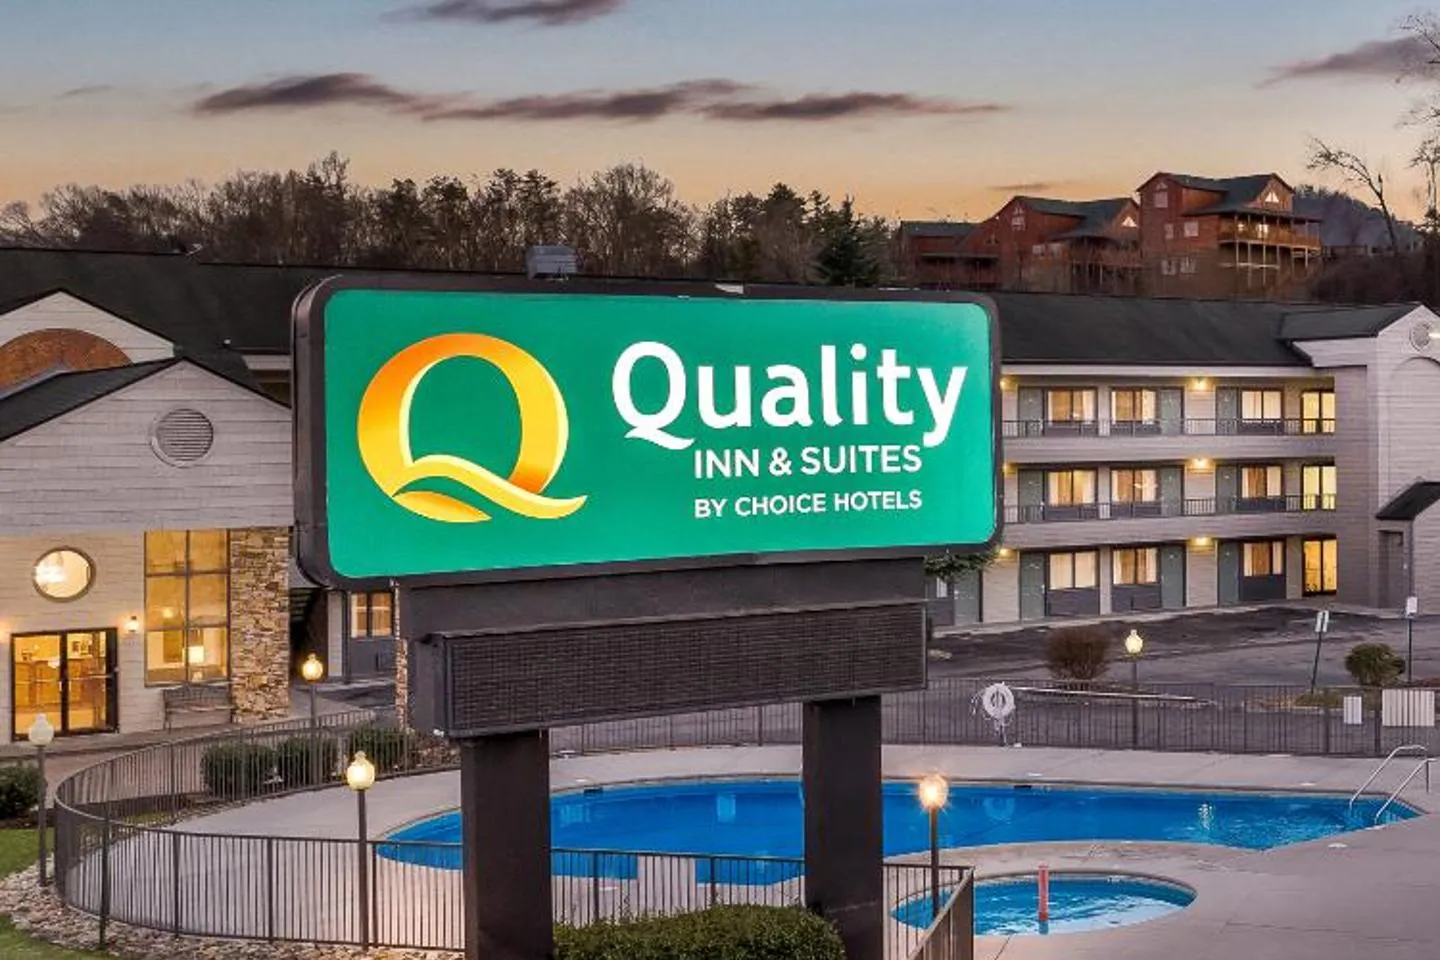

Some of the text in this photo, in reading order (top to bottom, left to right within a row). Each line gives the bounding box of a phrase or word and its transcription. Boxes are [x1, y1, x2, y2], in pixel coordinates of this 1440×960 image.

[611, 341, 969, 450] Quality
[694, 444, 923, 479] INN & SUITES
[694, 489, 923, 519] BY CHOICE HOTELS
